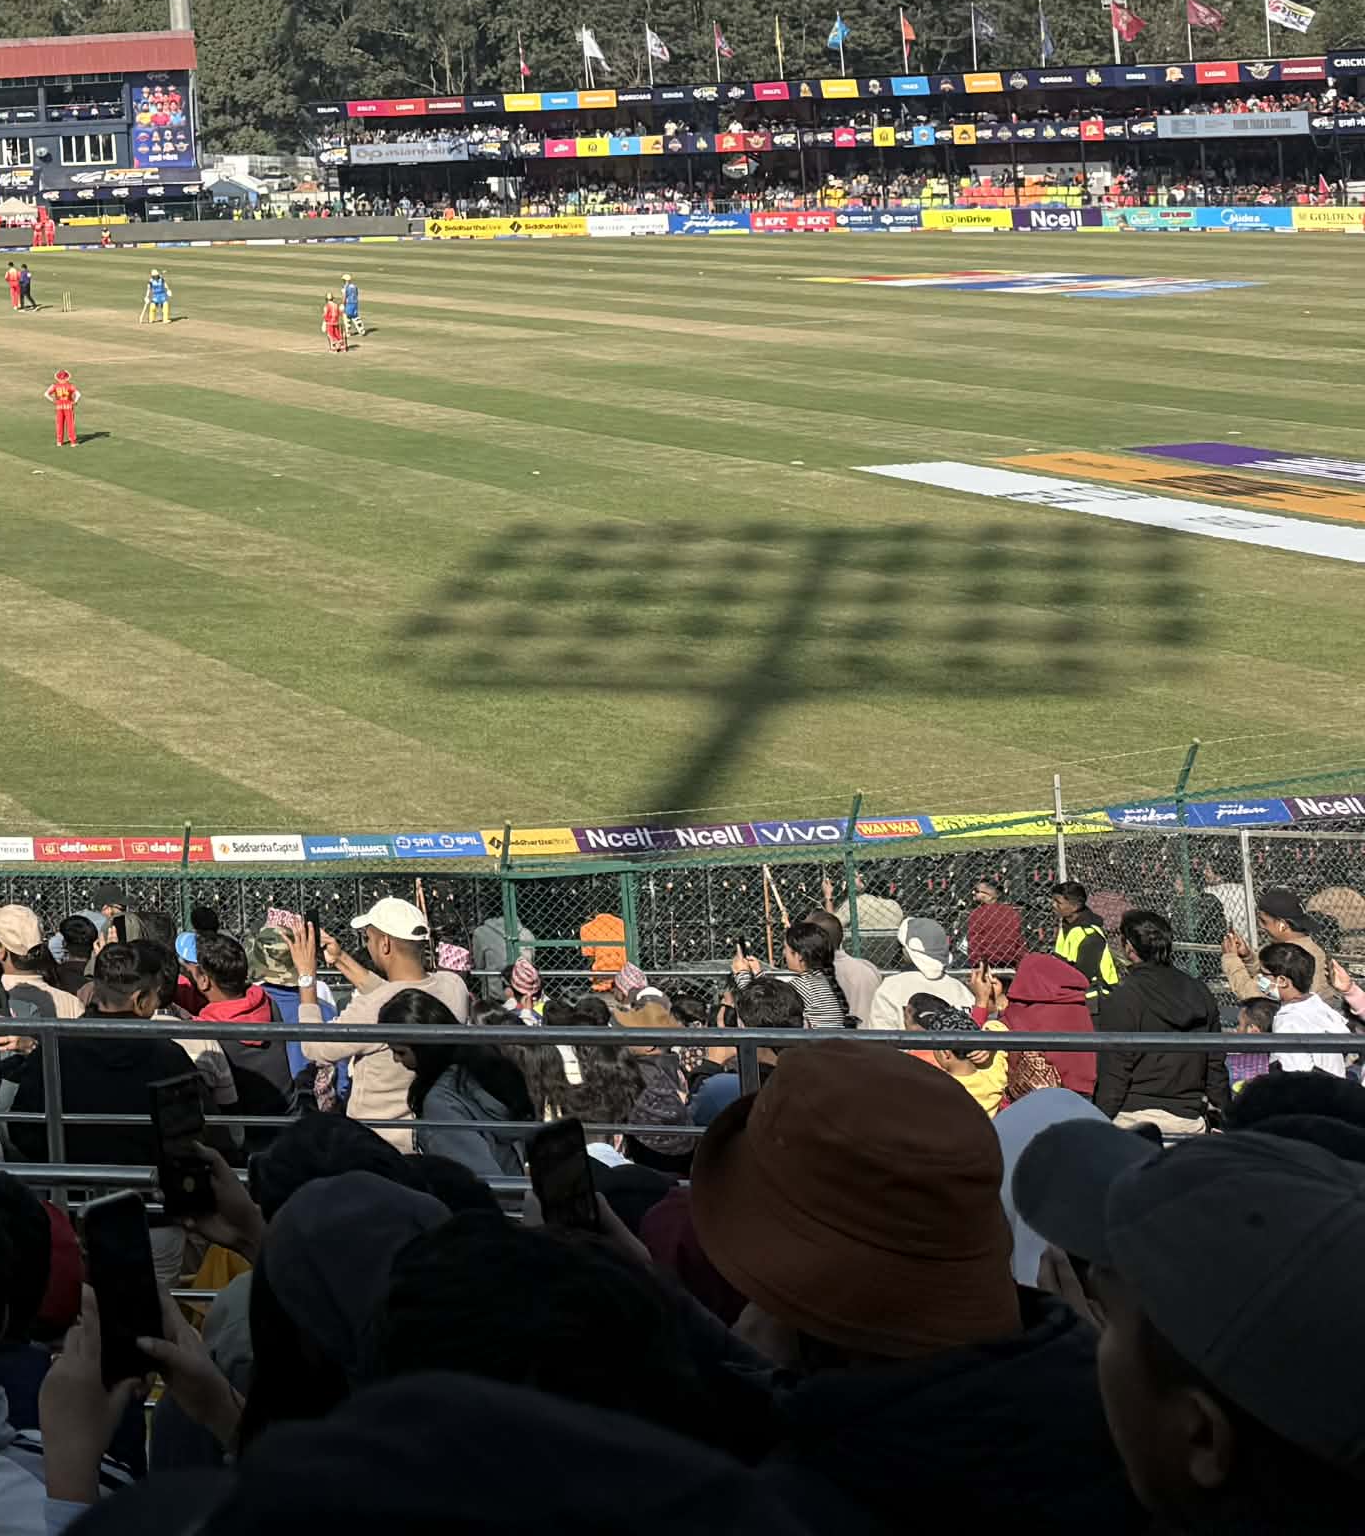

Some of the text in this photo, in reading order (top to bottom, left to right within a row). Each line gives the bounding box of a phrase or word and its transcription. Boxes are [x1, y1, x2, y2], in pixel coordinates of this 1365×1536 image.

[765, 216, 788, 226] KFC
[807, 215, 830, 225] KFC
[957, 215, 992, 223] inDrive
[1030, 210, 1083, 227] Ncell
[1300, 796, 1364, 817] Ncell
[585, 828, 653, 850] Ncell
[676, 824, 745, 848] Ncell
[760, 821, 840, 843] vivo
[232, 841, 299, 854] Siddhartha Capital
